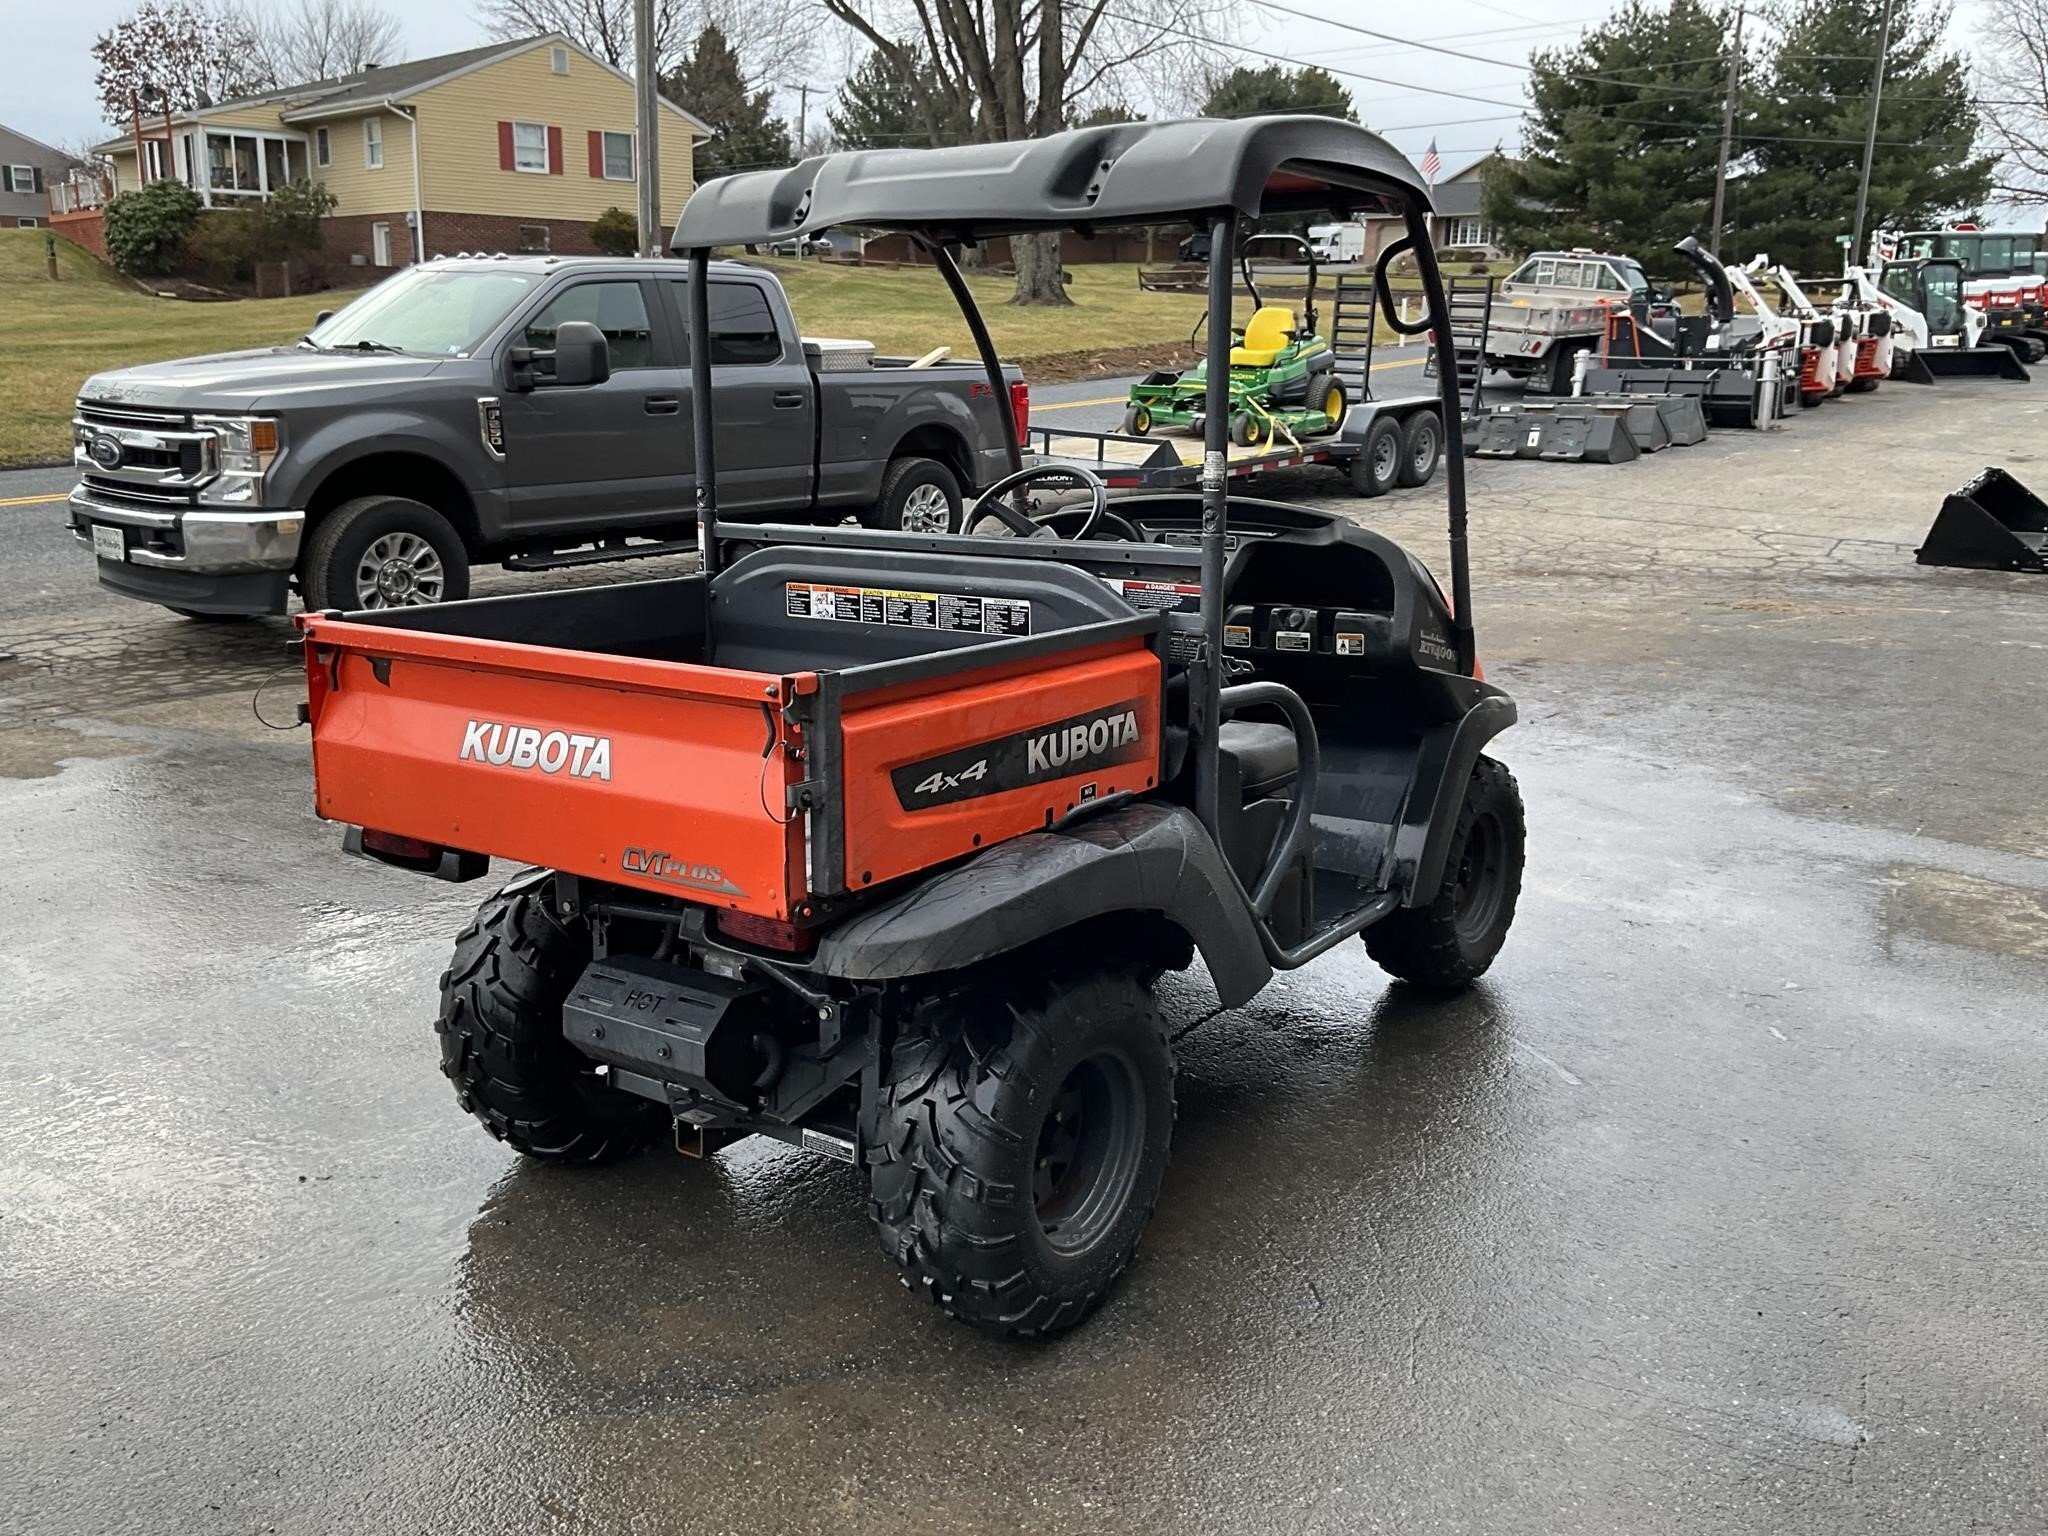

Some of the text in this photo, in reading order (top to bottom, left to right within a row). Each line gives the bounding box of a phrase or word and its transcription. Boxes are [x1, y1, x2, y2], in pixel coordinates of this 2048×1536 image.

[1150, 583, 1175, 591] DANGER
[459, 719, 612, 782] KUBOTA
[914, 710, 1140, 794] 4x4 KUBOTA
[1084, 786, 1093, 796] NO
[624, 989, 667, 1014] HOT
